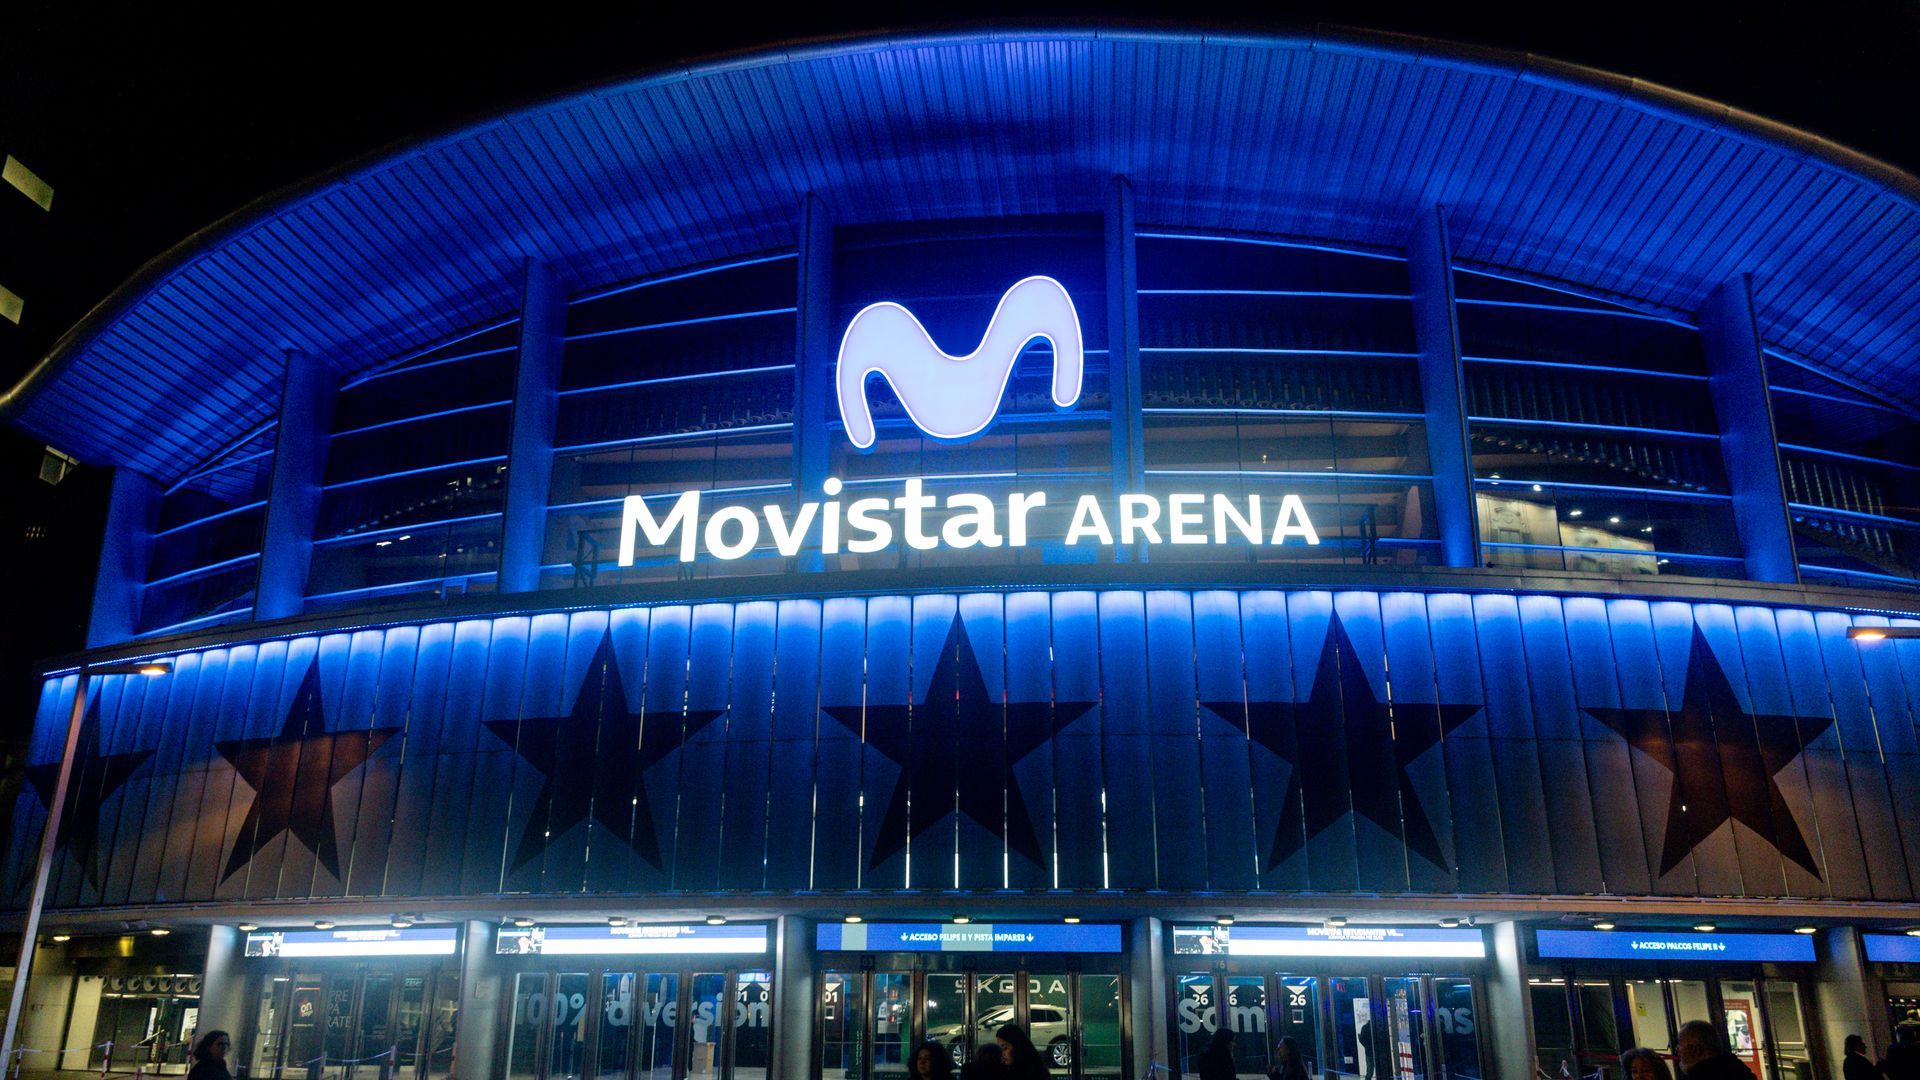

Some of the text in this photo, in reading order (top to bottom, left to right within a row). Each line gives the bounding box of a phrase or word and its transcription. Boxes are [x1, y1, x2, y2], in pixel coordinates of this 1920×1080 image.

[618, 477, 1320, 567] Movistar ARENA
[909, 933, 938, 941] ACCESO
[939, 933, 961, 941] FELIPE
[967, 933, 973, 941] Y
[974, 933, 994, 942] PISTA
[994, 933, 1025, 942] IMPARES
[1639, 942, 1665, 950] ACCESO
[1666, 942, 1692, 950] PALCOS
[1693, 942, 1712, 950] FELIPE
[1290, 994, 1306, 1006] 26
